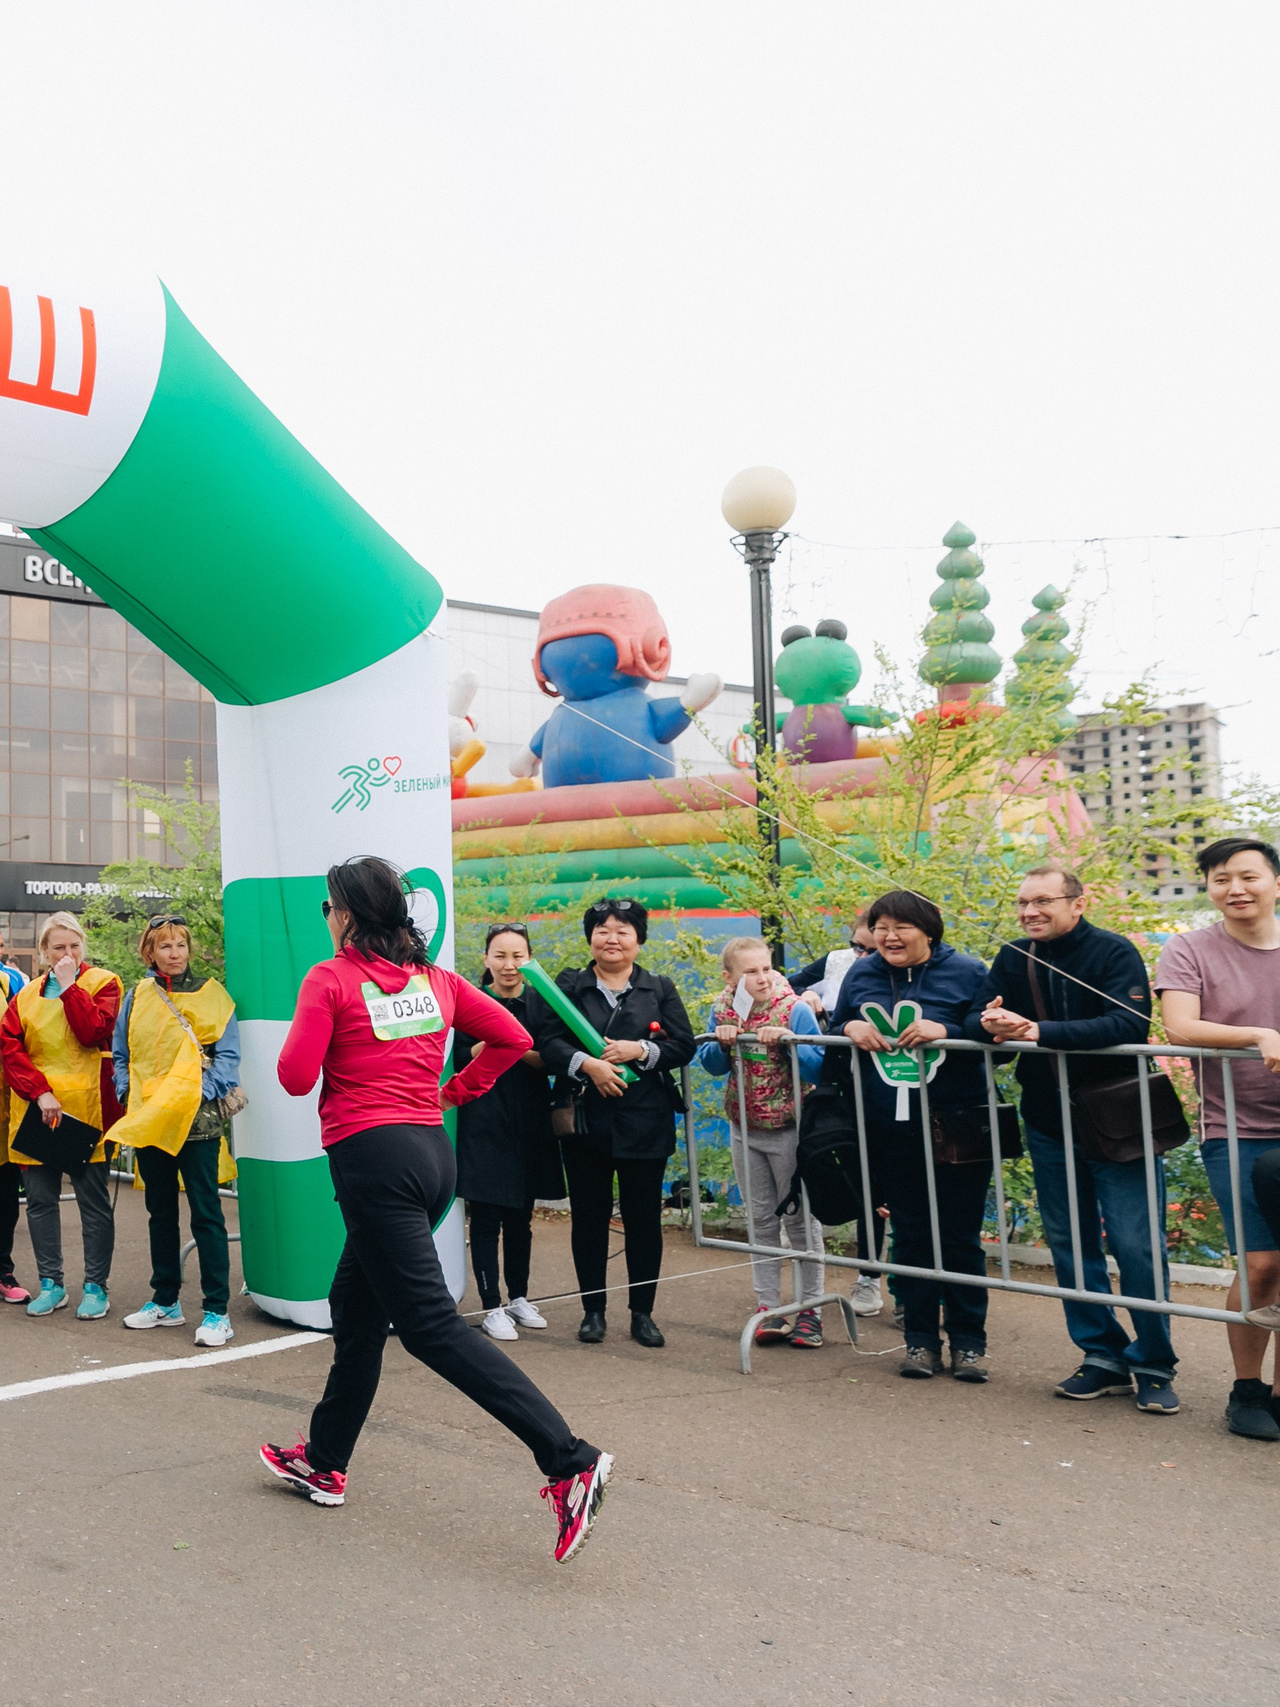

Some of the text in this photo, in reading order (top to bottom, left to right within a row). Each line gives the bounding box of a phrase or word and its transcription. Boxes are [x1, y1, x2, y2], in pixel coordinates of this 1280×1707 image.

[25, 554, 93, 594] ВСЕ
[394, 774, 440, 793] ЗЕЛЕНЫЙ
[393, 996, 435, 1018] 0348
